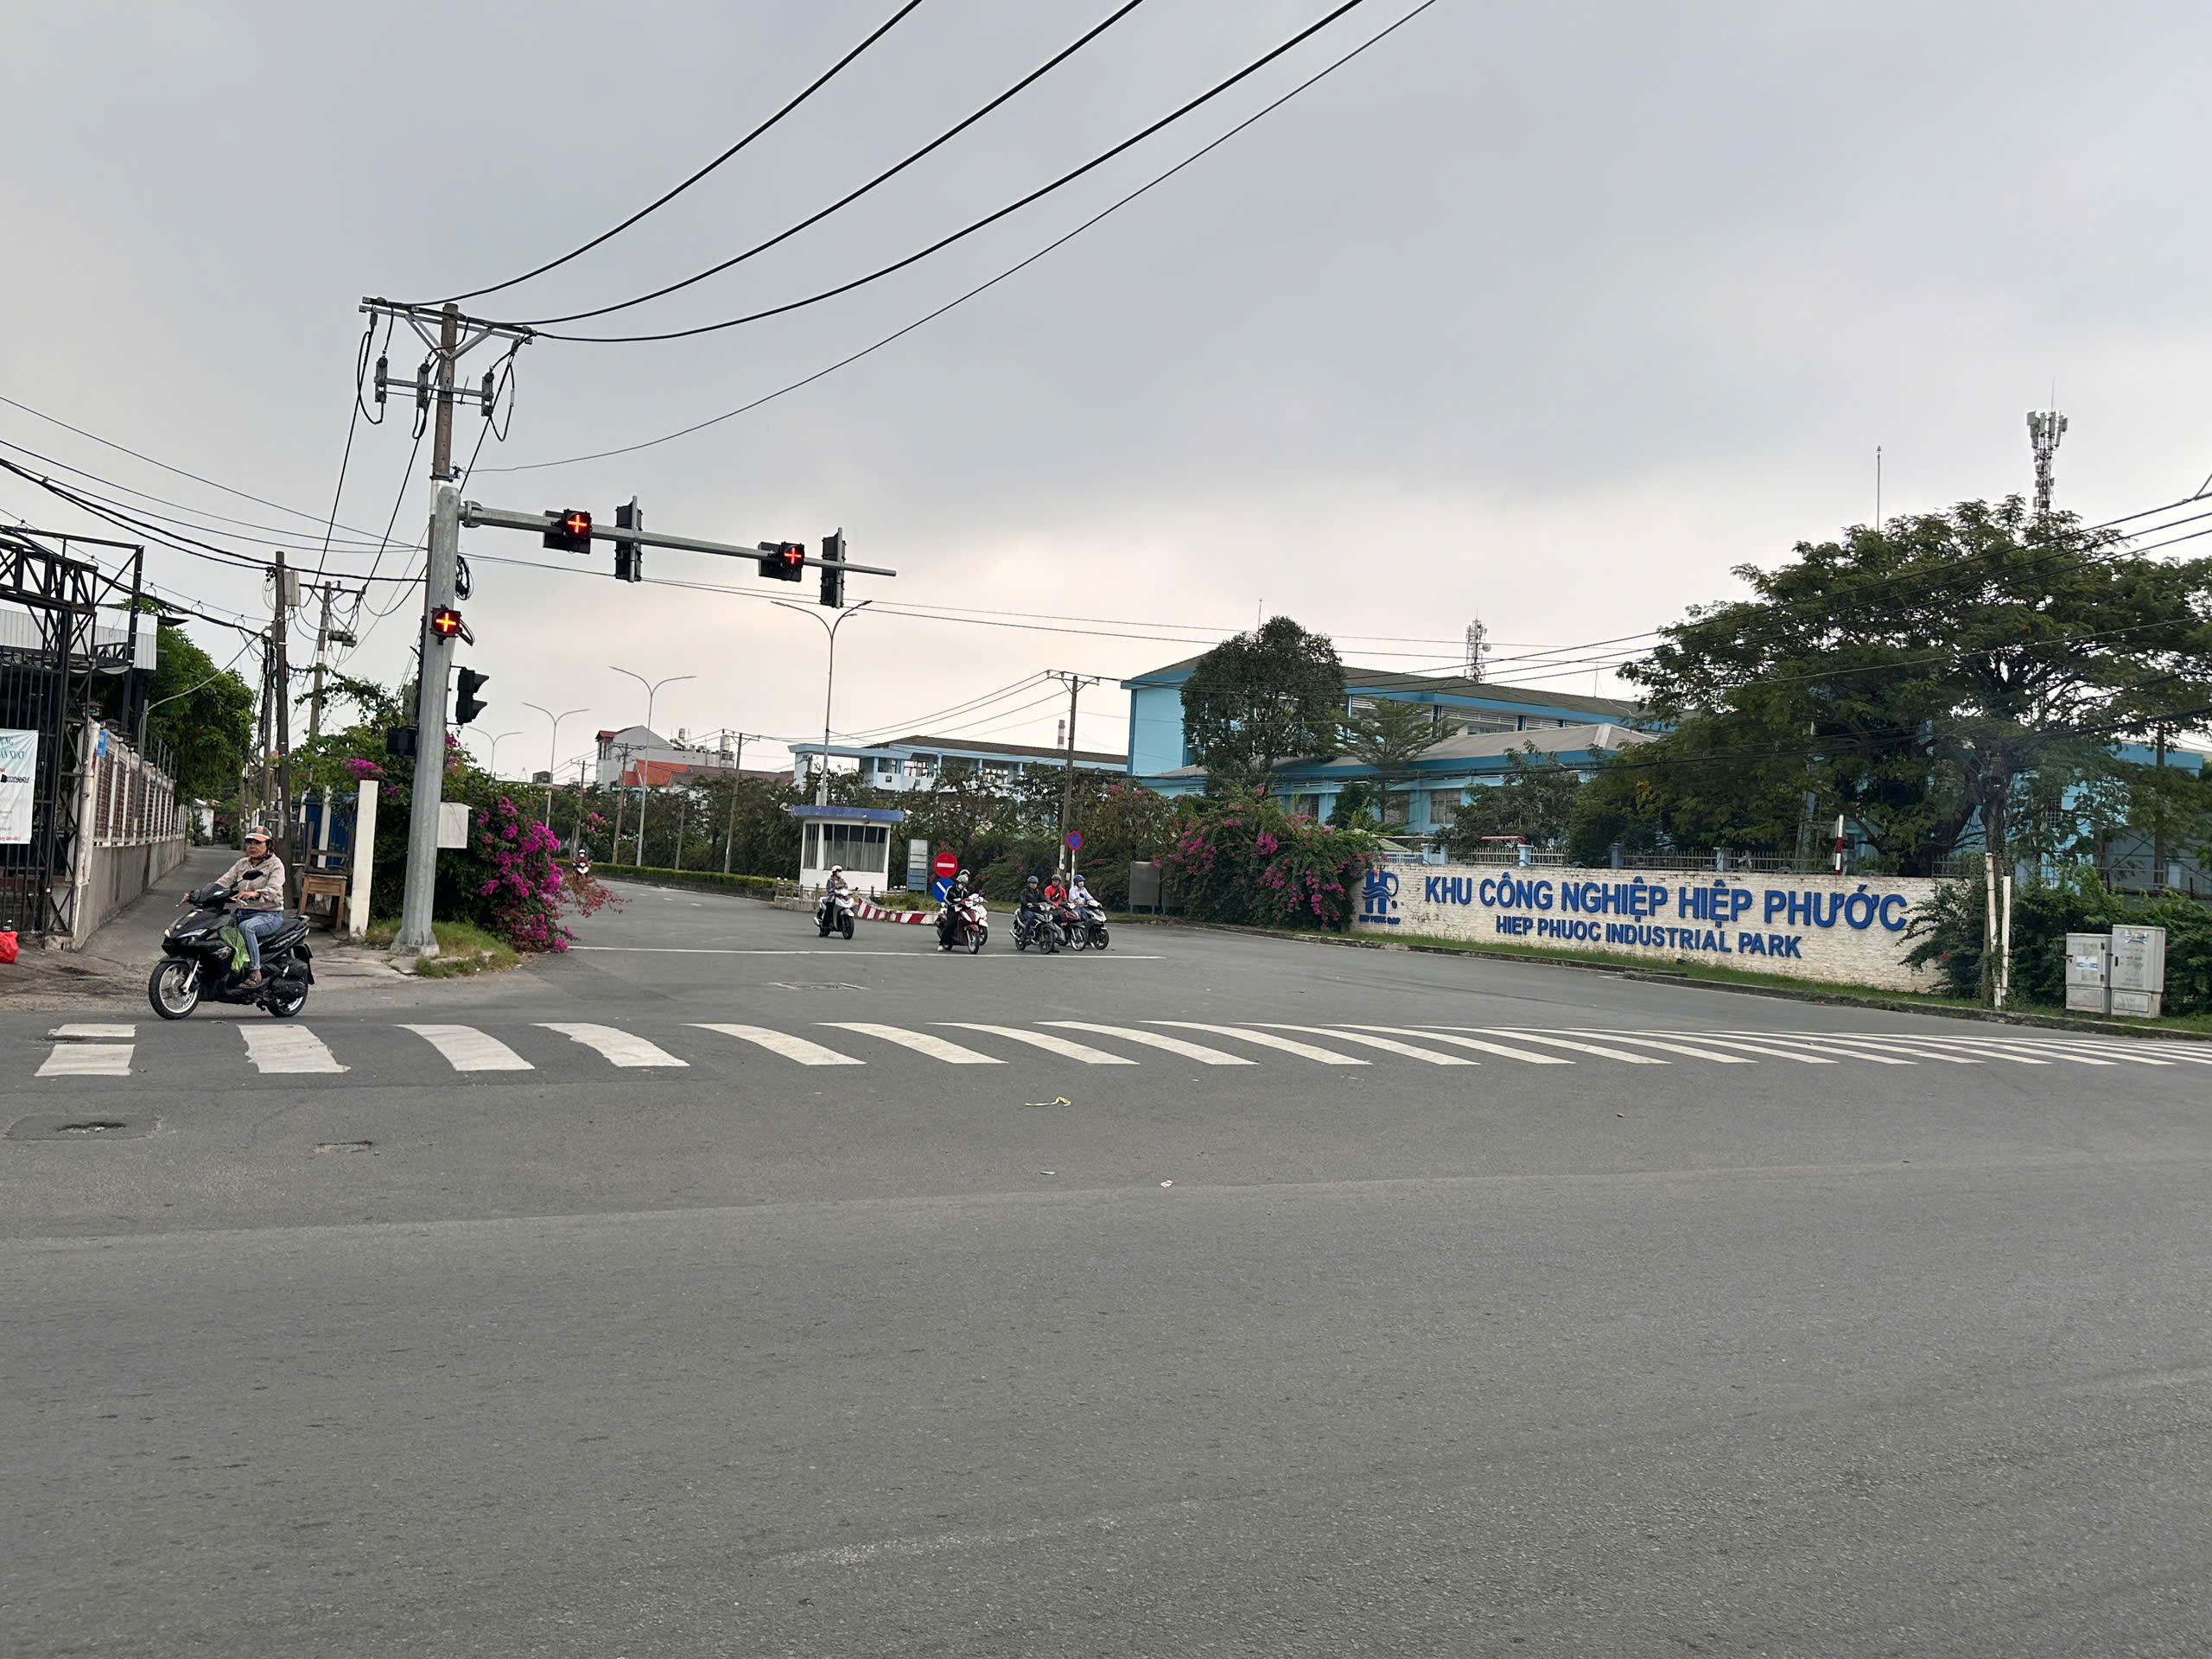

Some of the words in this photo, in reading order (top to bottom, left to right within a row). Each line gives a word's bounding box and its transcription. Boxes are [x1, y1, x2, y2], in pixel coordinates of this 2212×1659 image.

[1425, 876, 1471, 906] KHU
[1479, 872, 1553, 910] CÔNG
[1560, 876, 1668, 922] NGHIỆP
[1678, 879, 1752, 928] HIỆP
[1764, 884, 1907, 931] PHƯỚC
[1496, 916, 1534, 936] HIEP
[1537, 918, 1601, 942] PHUOC
[1605, 923, 1732, 953] INDUSTRIAL
[1738, 932, 1802, 958] PARK
